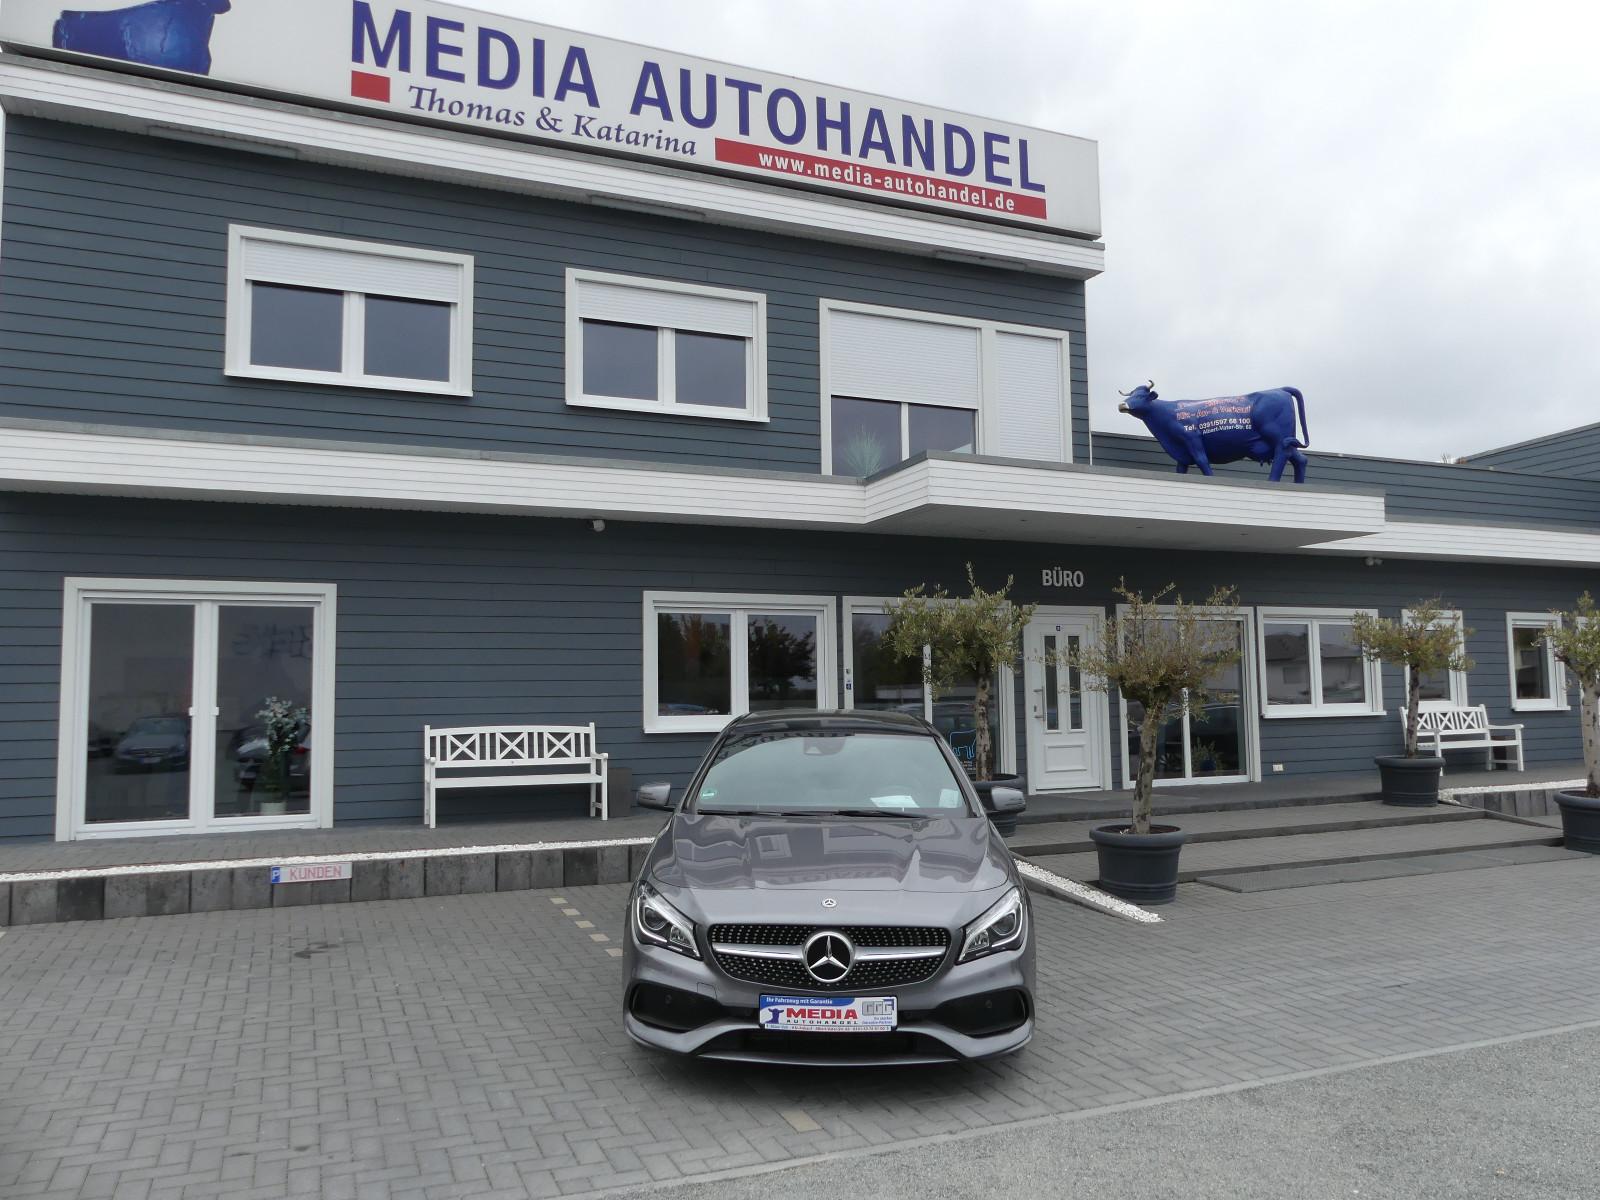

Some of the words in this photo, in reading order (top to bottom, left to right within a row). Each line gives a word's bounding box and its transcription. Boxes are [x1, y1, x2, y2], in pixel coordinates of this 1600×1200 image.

[351, 0, 600, 109] MEDIA
[629, 60, 1046, 194] AUTOHANDEL
[408, 84, 526, 127] Thomas
[535, 106, 564, 133] &
[571, 113, 698, 157] Katarina
[758, 152, 1016, 213] www.media-autohandel.de
[1042, 566, 1084, 588] BÜRO
[272, 869, 280, 879] P
[289, 866, 342, 881] KUNDEN
[787, 1008, 858, 1020] MEDIA
